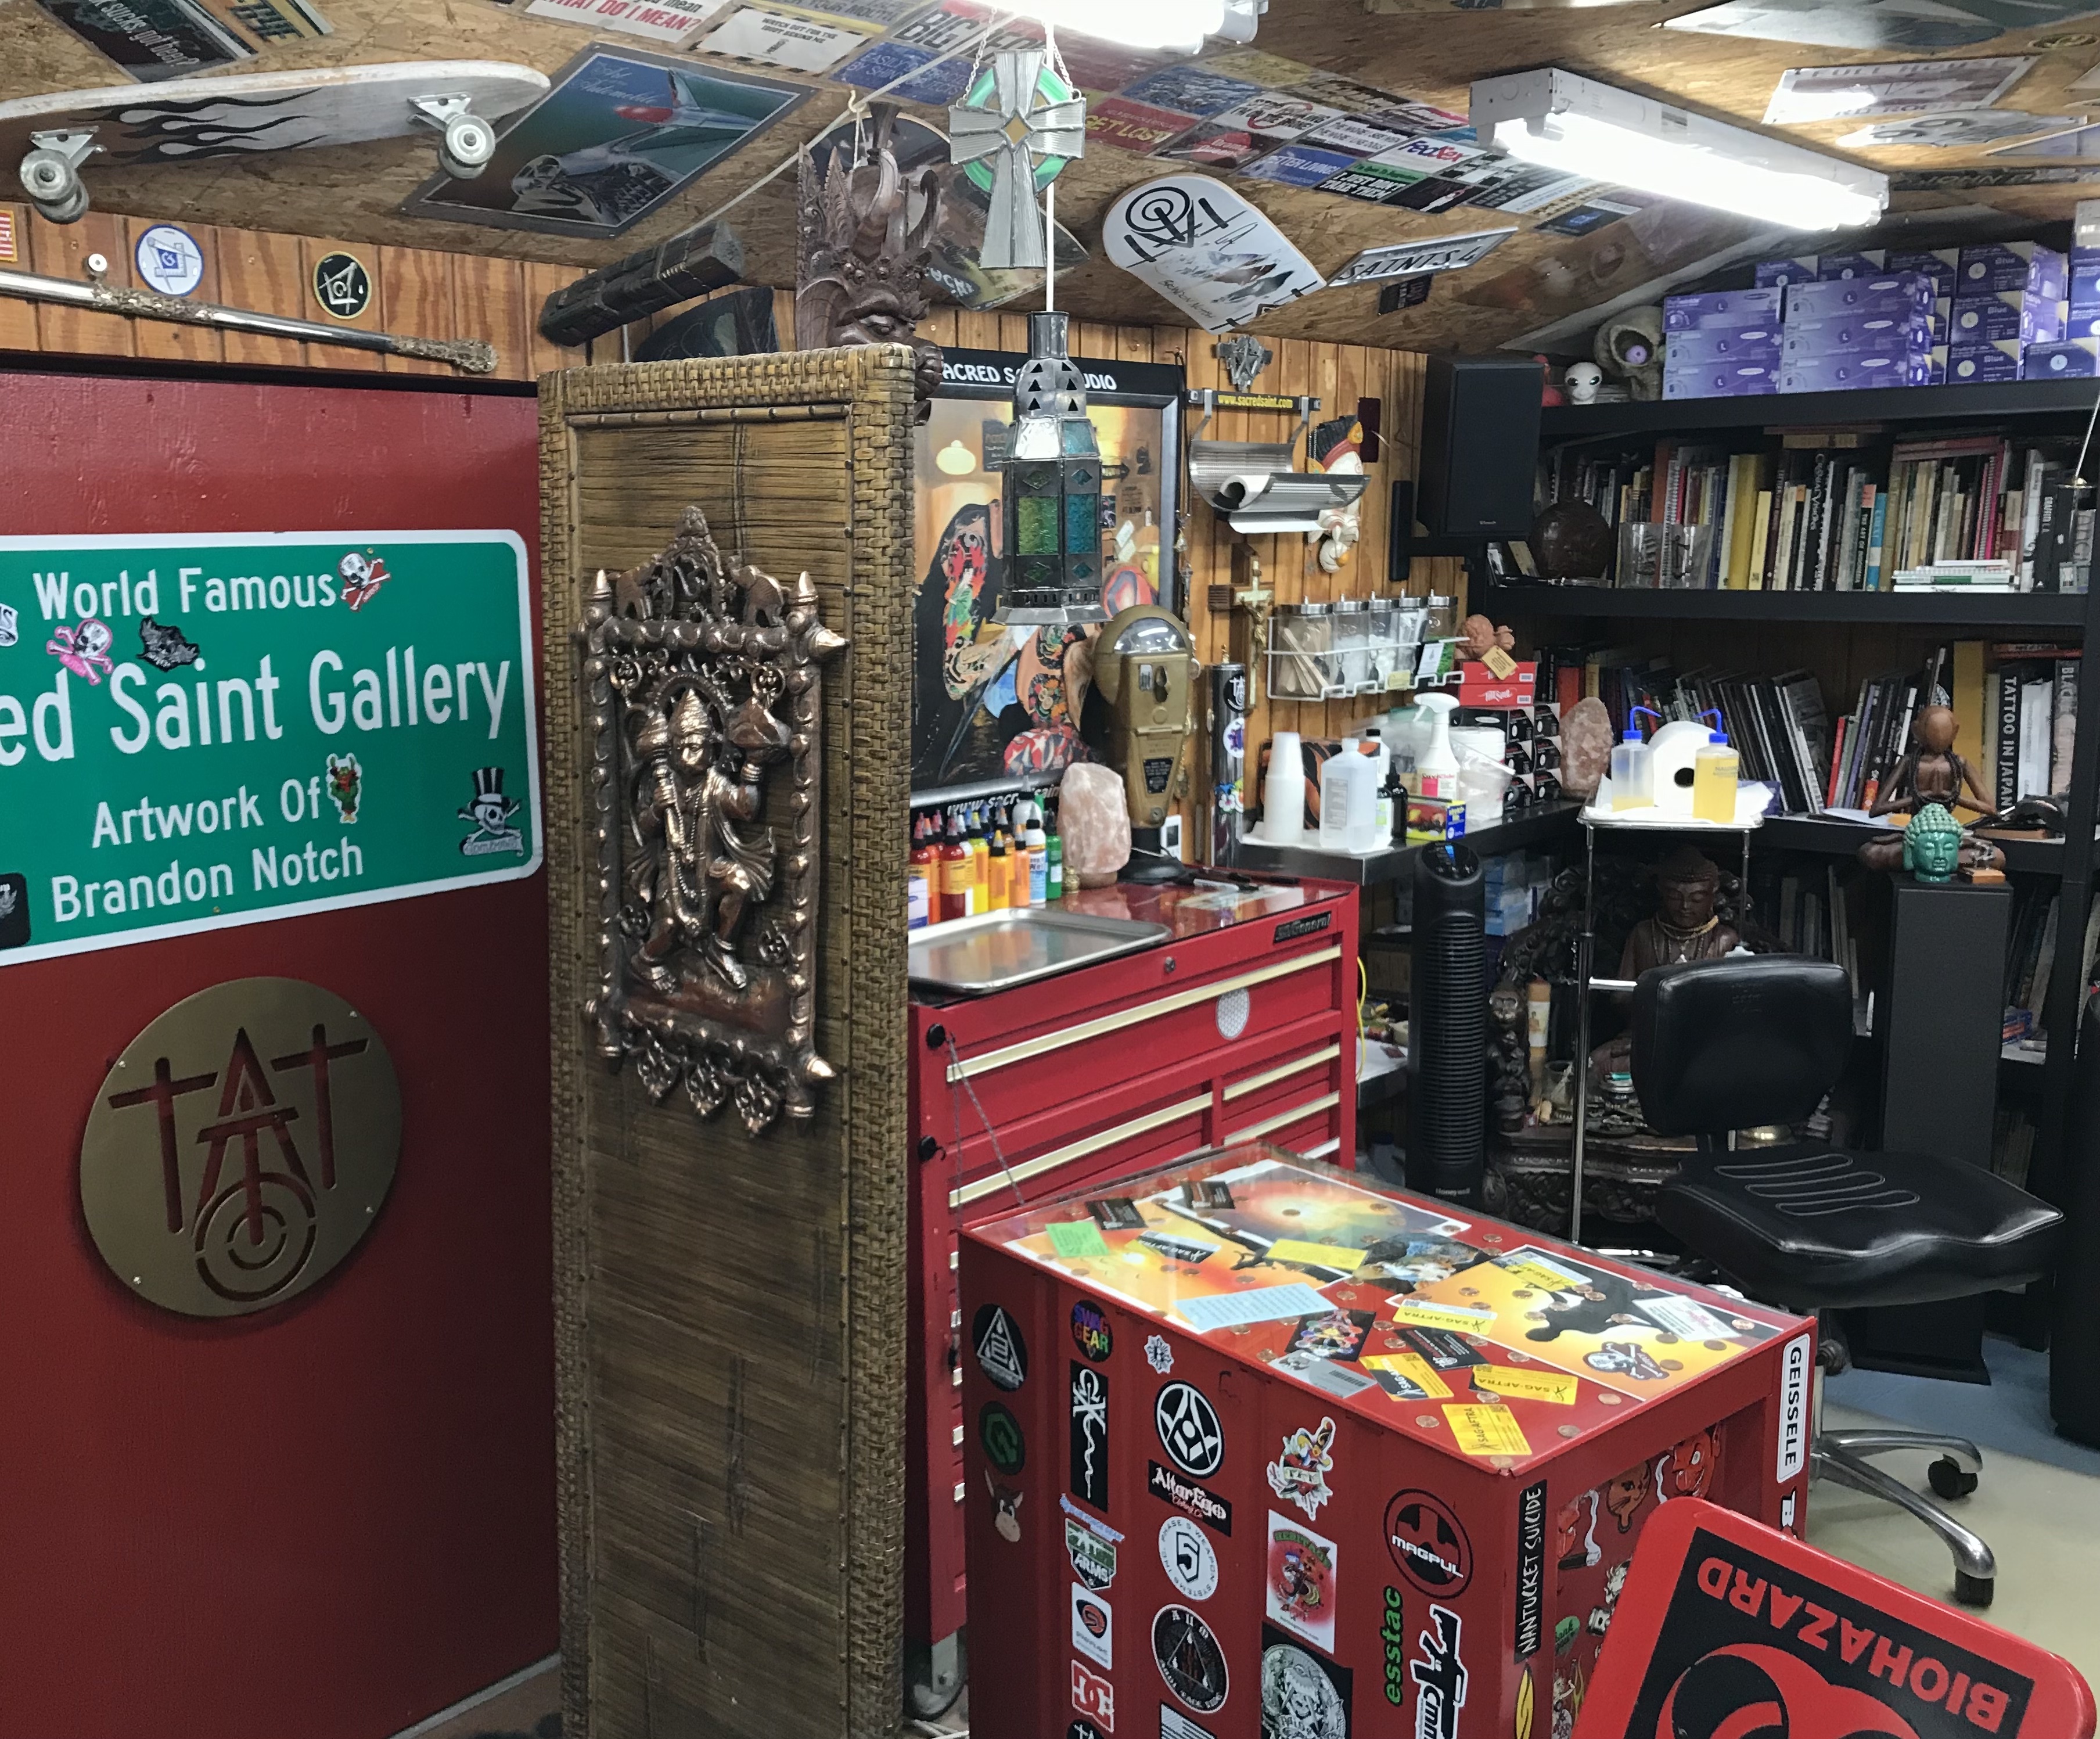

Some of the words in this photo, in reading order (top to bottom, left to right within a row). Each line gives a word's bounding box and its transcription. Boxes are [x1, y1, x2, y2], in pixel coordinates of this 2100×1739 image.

[595, 0, 629, 16] DO
[634, 8, 703, 32] MEAN?
[942, 365, 1001, 383] ACRED
[1084, 373, 1117, 391] UDIO
[1218, 394, 1293, 409] www.sacredsaint.com
[33, 569, 159, 620] World
[179, 566, 336, 613] Famous
[109, 653, 283, 754] Saint
[308, 645, 510, 739] Gallery
[2003, 676, 2017, 735] TATTOO
[2002, 741, 2015, 756] IN
[2000, 761, 2014, 806] JAPAN
[91, 784, 264, 849] Artwork
[280, 776, 321, 824] Of
[52, 860, 234, 923] Brandon
[251, 836, 364, 891] Notch
[1074, 1321, 1109, 1353] GEAR
[1783, 1346, 1801, 1467] GEISSELE
[1161, 1519, 1182, 1542] PHASE
[1524, 1487, 1542, 1550] SUICIDE
[1073, 1553, 1109, 1582] ARMS
[1195, 1529, 1216, 1582] WEAPON
[1392, 1535, 1463, 1578] MAGPUL
[1174, 1576, 1212, 1597] SYSTEMS
[1518, 1554, 1540, 1654] NANTUCKET
[1382, 1587, 1403, 1705] esstac
[1697, 1557, 2010, 1734] BIOHAZARD
